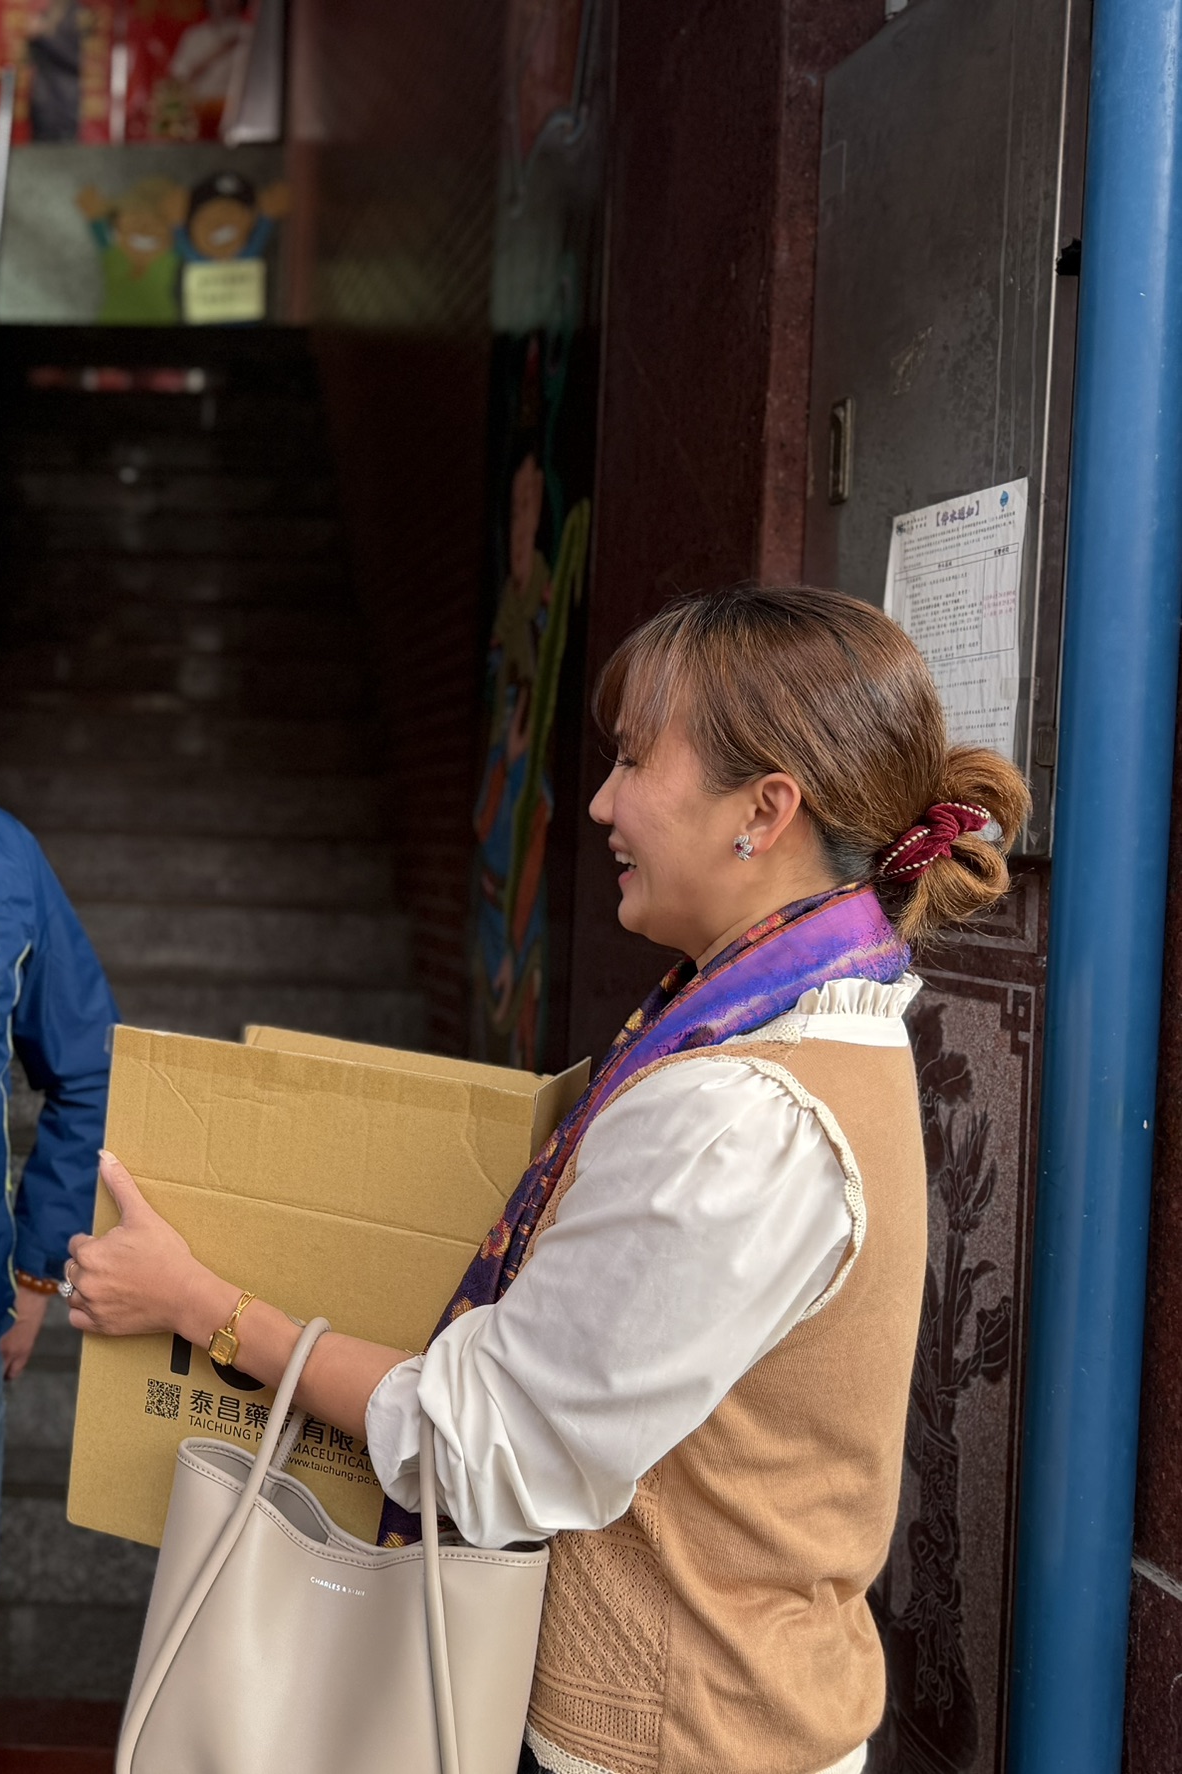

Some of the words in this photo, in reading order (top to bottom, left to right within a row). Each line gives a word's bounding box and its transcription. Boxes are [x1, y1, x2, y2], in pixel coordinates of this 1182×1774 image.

[188, 1389, 370, 1457] 泰昌藥有限
[188, 1414, 251, 1441] TAICHUNG
[288, 1456, 379, 1485] www.taichung-pc.c
